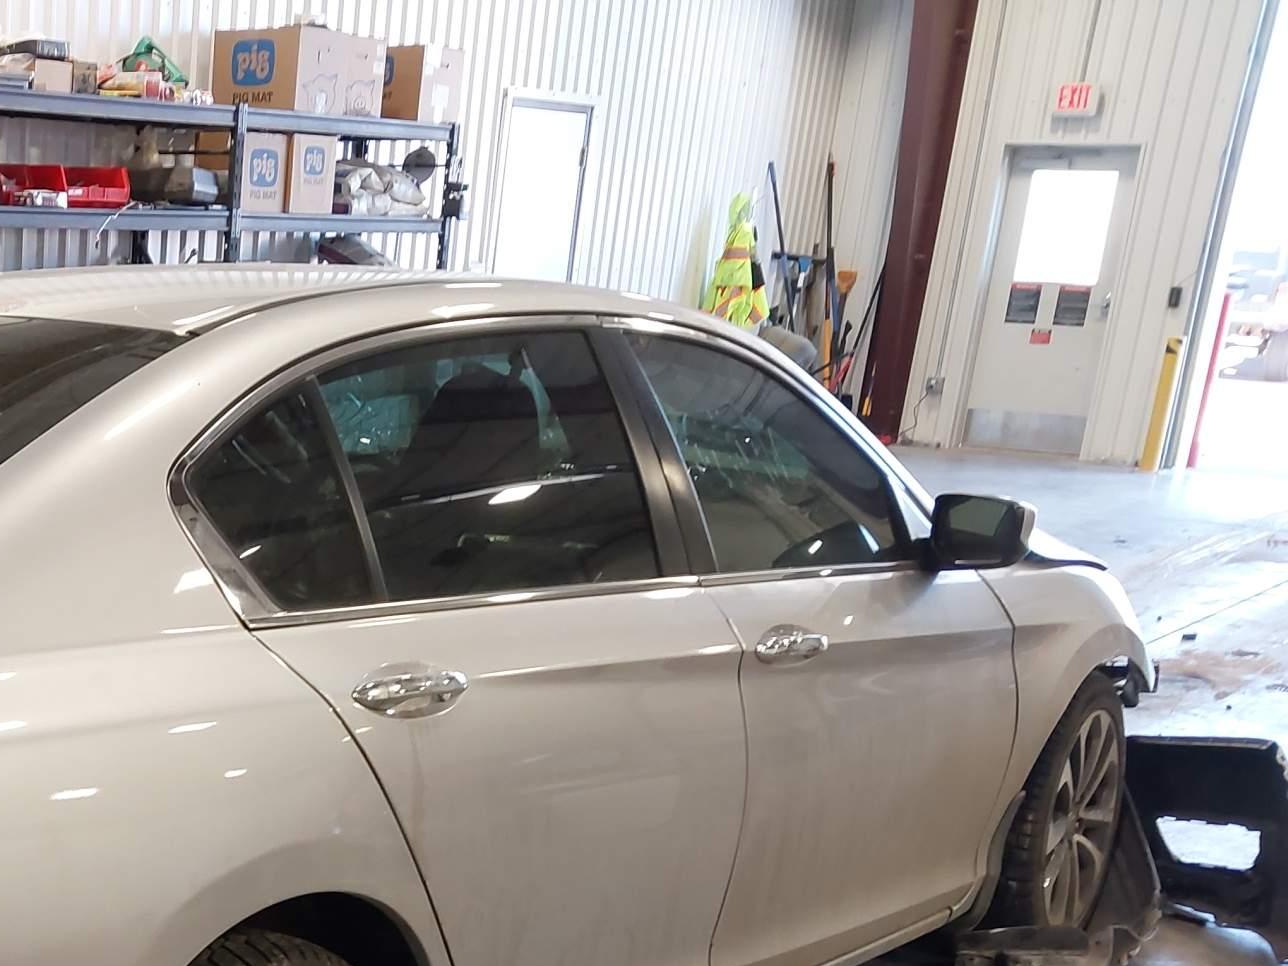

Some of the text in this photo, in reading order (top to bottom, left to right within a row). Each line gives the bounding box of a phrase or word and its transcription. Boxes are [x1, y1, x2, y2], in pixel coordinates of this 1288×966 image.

[236, 43, 270, 80] pig
[232, 91, 273, 104] PIG MAT
[1057, 84, 1091, 110] EXIT
[253, 152, 275, 182] pig
[306, 149, 323, 172] pig
[263, 190, 277, 201] MAT
